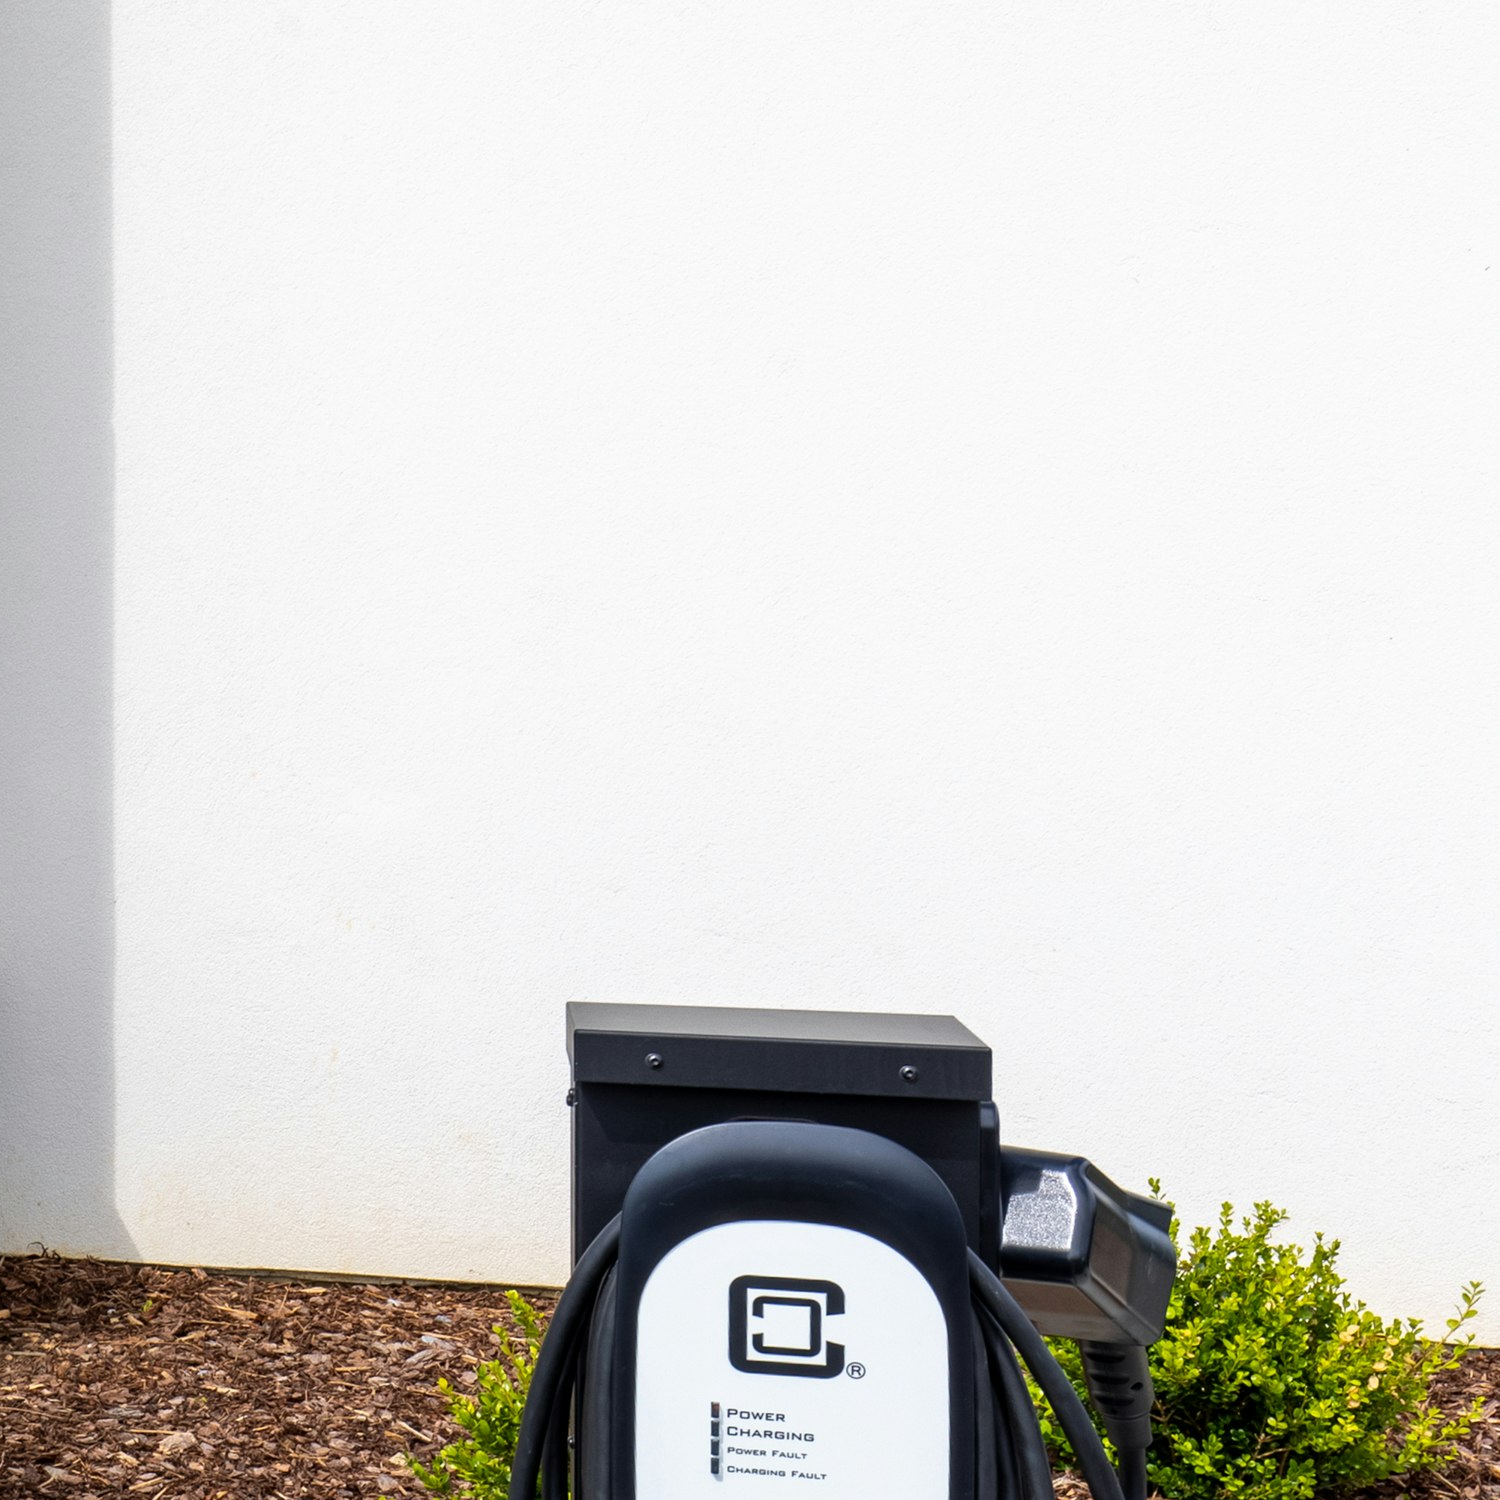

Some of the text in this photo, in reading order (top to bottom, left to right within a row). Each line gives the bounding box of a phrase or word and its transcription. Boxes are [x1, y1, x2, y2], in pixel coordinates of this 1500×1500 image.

[727, 1408, 786, 1422] POWER
[727, 1426, 815, 1442] CHARGING
[727, 1446, 808, 1460] POWER FAULT
[727, 1465, 827, 1480] CHARGING FAULT
